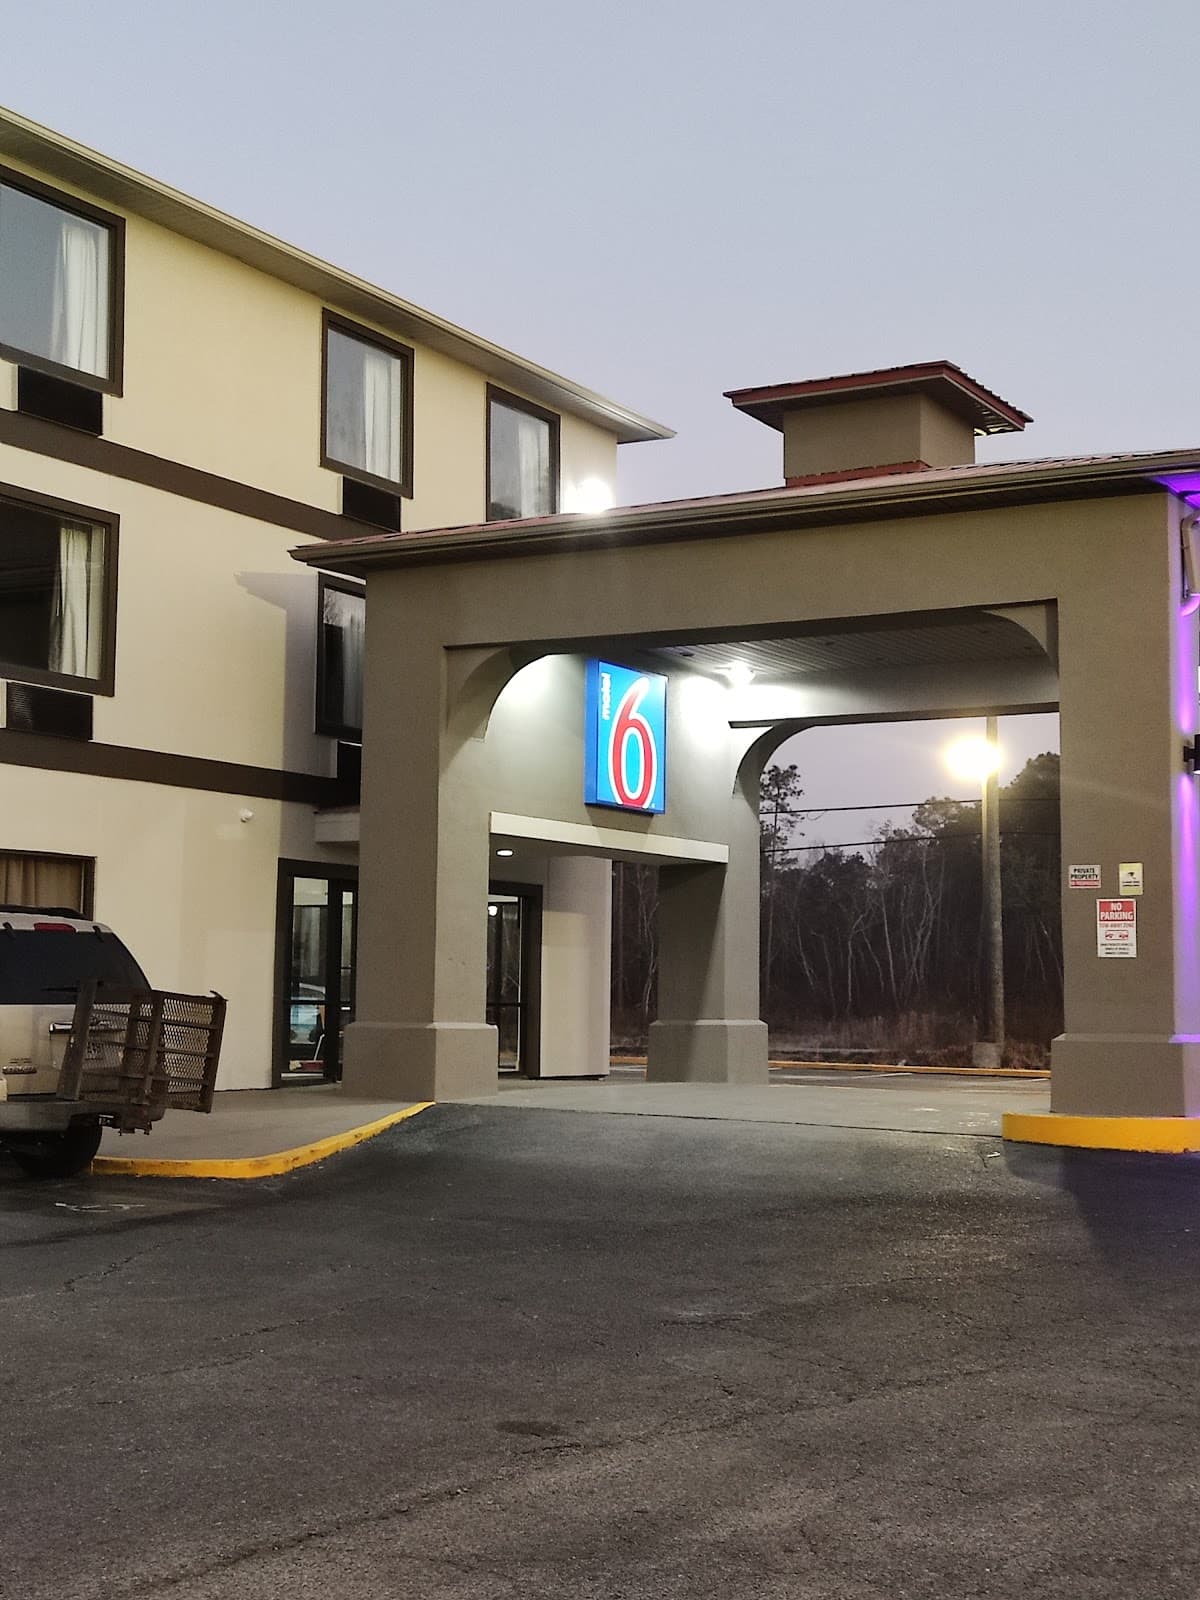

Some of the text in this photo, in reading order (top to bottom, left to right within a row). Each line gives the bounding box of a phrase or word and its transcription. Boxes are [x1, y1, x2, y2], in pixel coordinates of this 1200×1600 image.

[601, 673, 611, 721] motel
[608, 676, 657, 808] 6
[1100, 911, 1134, 921] PARKING
[1110, 902, 1122, 911] NO
